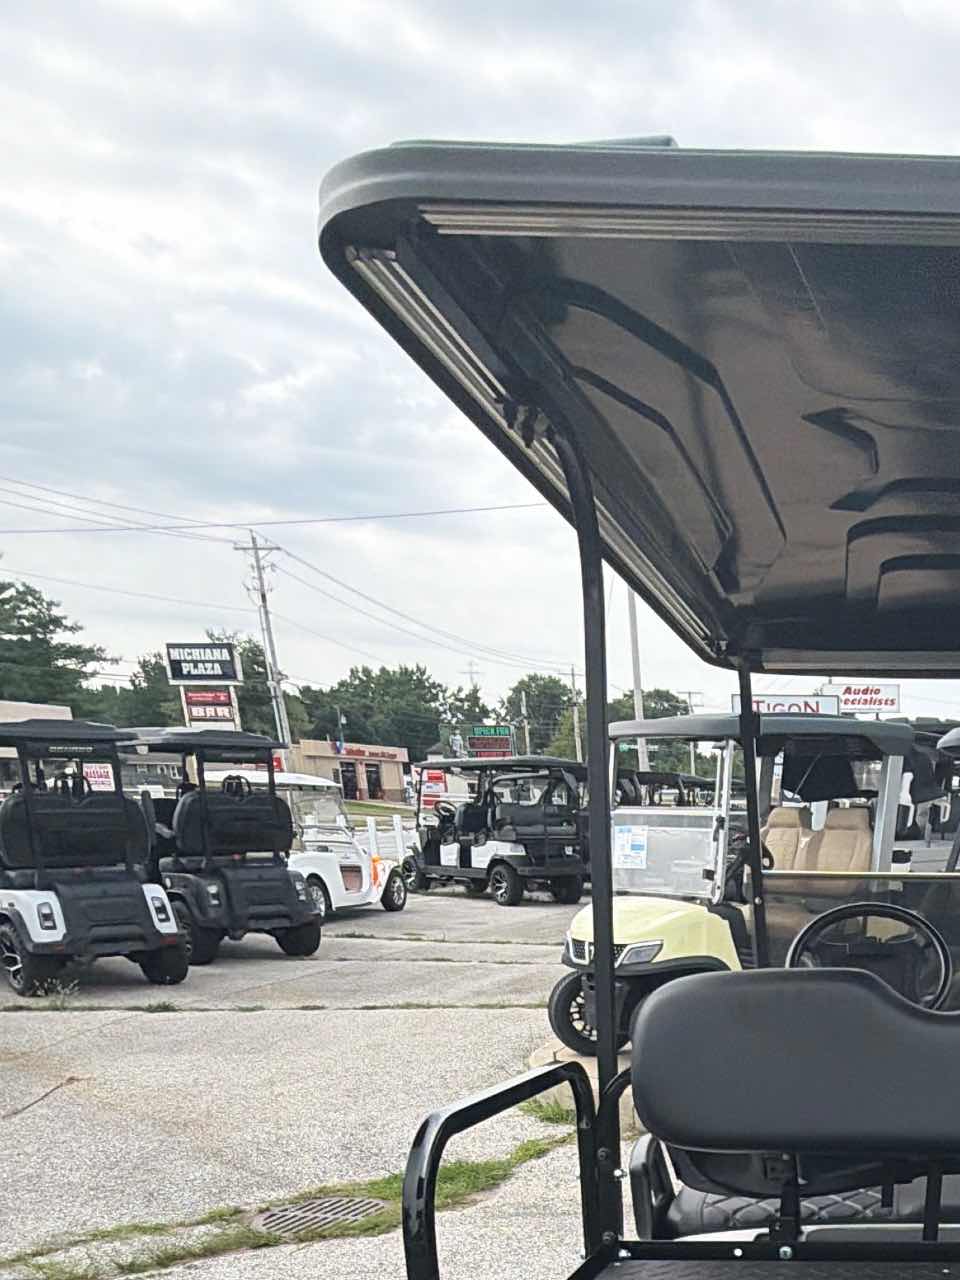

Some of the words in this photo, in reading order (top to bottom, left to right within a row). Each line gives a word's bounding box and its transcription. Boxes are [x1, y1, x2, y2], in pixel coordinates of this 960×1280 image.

[168, 647, 231, 661] MICHIANA
[181, 662, 223, 675] PLAZA
[842, 686, 881, 696] Audio
[752, 700, 820, 714] TIGON
[840, 696, 897, 706] ecialists
